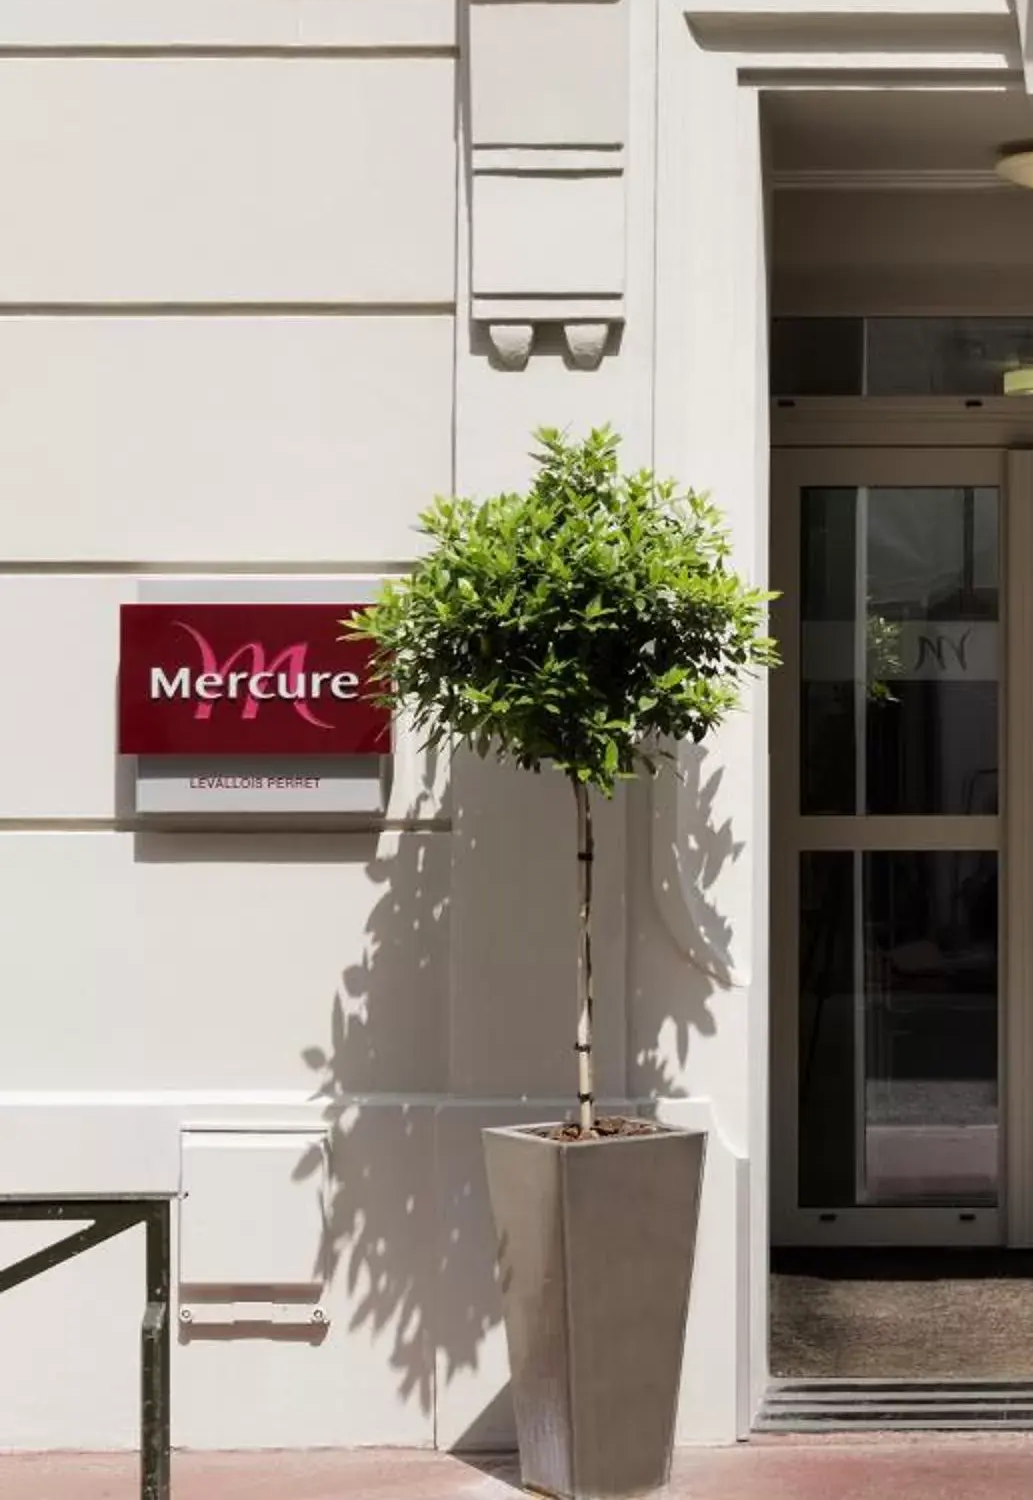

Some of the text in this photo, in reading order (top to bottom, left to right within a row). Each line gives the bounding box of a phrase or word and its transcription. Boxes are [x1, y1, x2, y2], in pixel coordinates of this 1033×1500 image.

[150, 666, 359, 700] Mercure
[190, 776, 321, 789] LEVALLOIS PERRET
